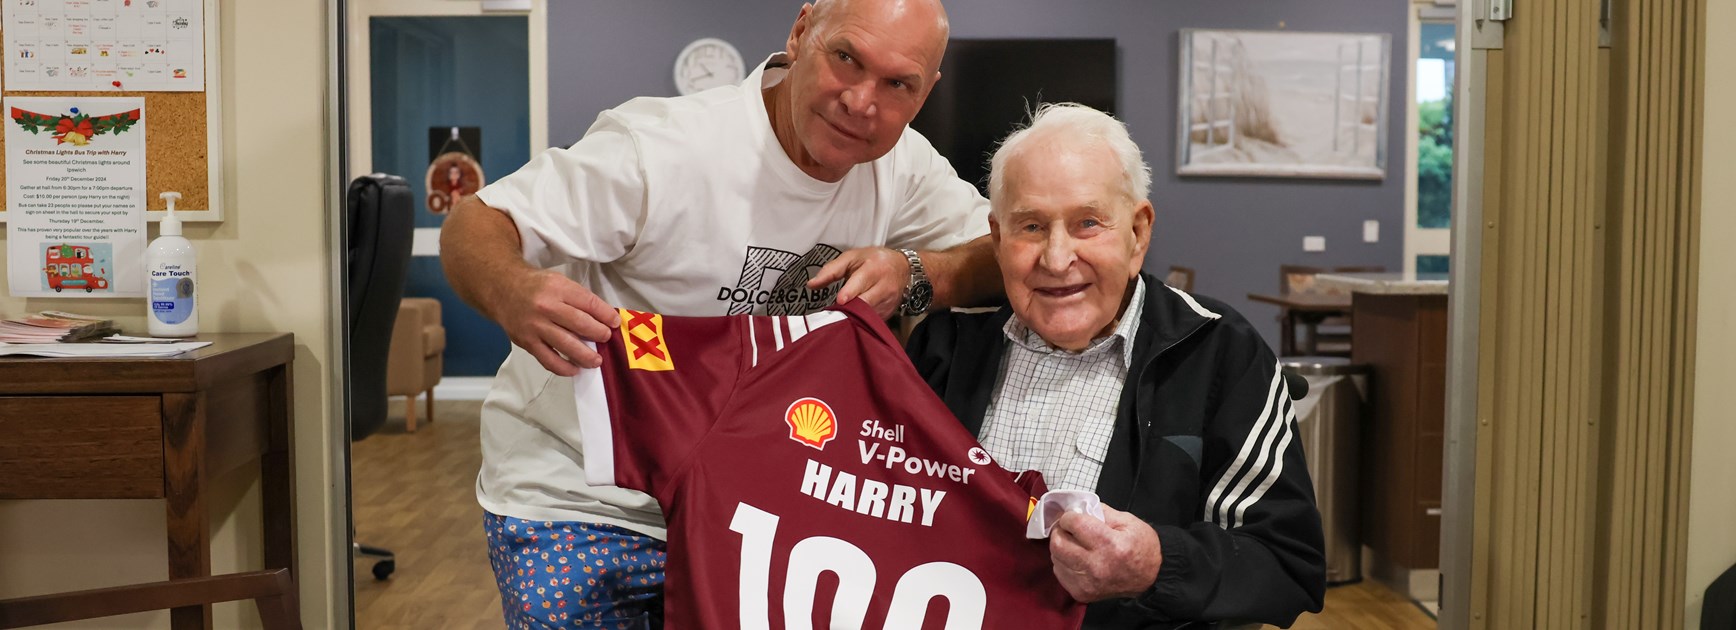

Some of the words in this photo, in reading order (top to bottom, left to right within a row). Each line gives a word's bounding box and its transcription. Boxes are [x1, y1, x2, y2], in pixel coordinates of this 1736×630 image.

[716, 286, 838, 304] DOLCE&GABB
[859, 419, 904, 443] Shell
[858, 439, 976, 485] V-Power
[800, 458, 947, 528] HARRY
